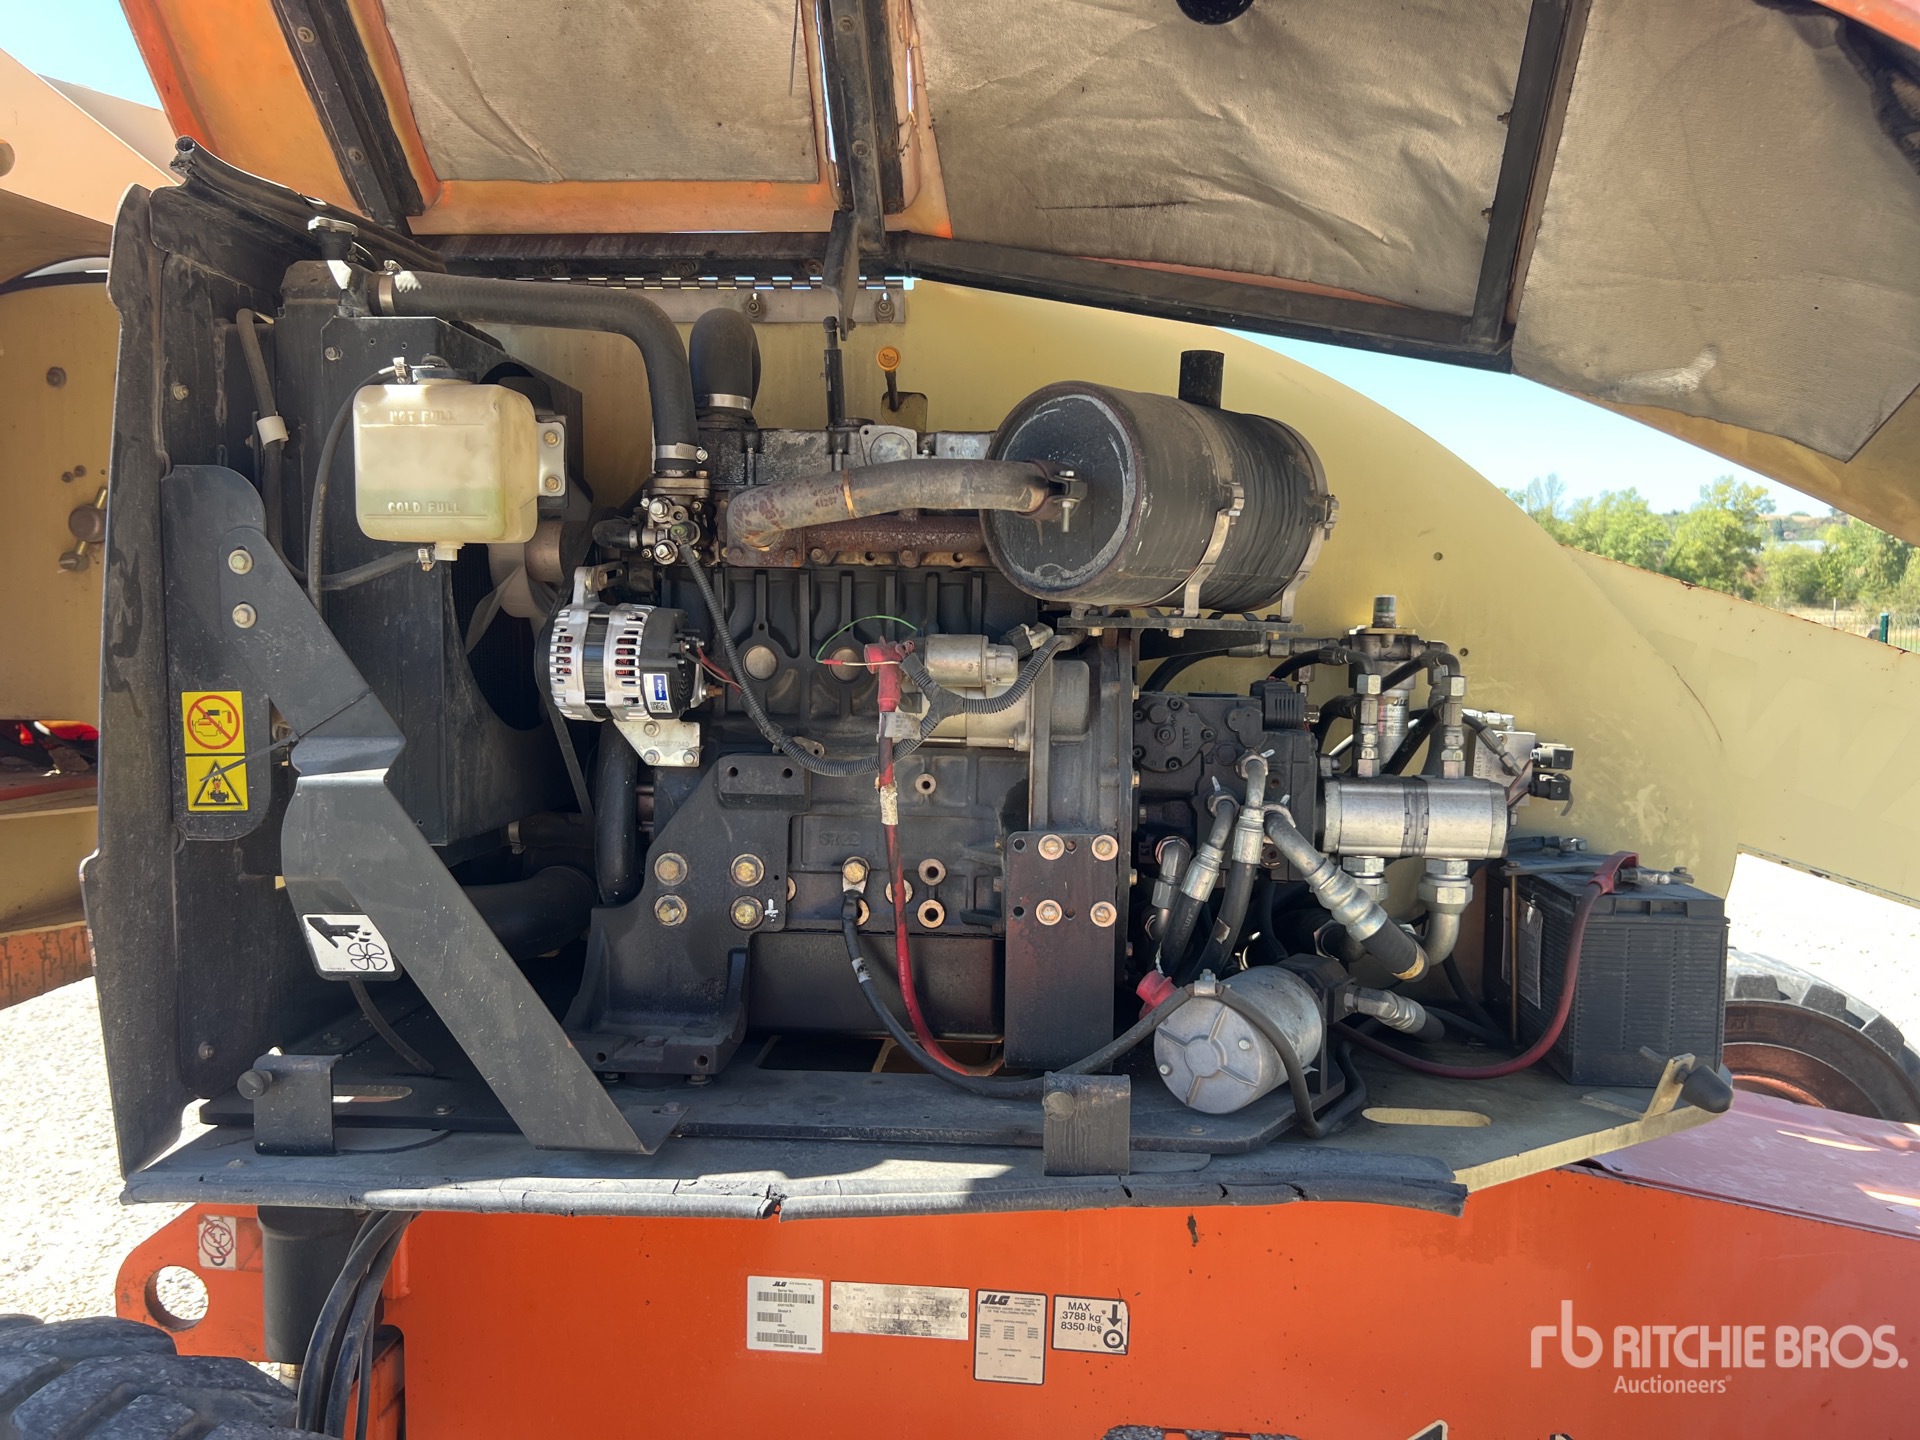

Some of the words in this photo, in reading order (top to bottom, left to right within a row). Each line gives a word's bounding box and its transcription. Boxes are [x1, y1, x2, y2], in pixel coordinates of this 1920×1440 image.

[387, 501, 421, 513] COLD
[427, 501, 461, 513] FULL
[981, 1294, 1010, 1306] JLG
[1067, 1302, 1091, 1312] MAX
[1062, 1311, 1086, 1321] 3788
[1089, 1313, 1101, 1324] kg
[1061, 1321, 1085, 1331] 8350
[1087, 1323, 1102, 1332] lbs
